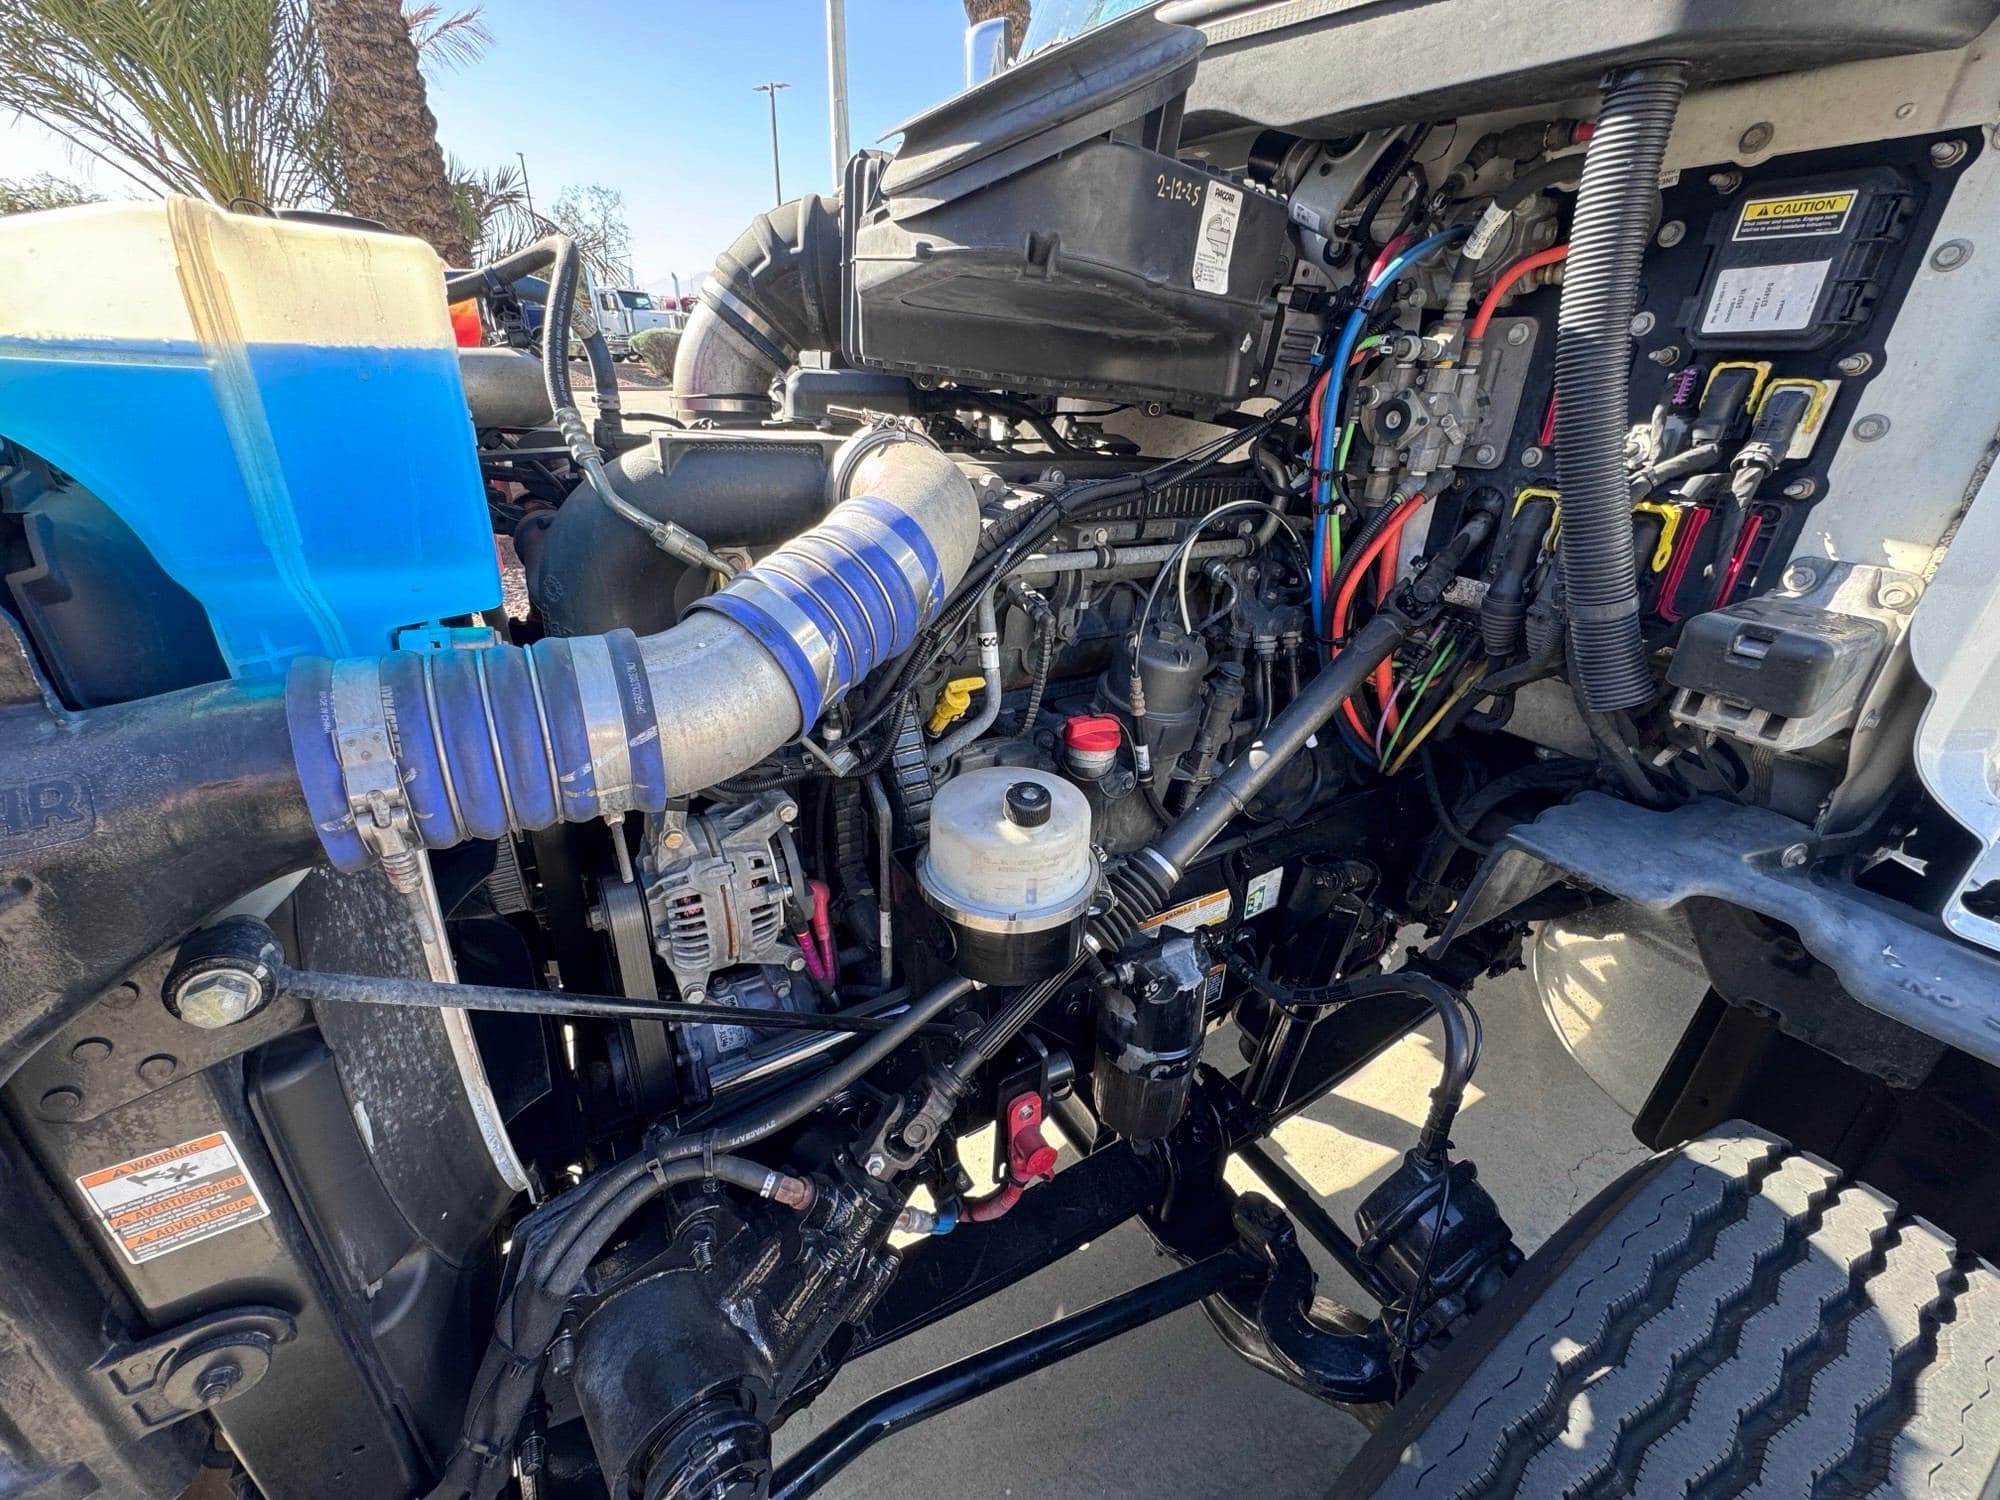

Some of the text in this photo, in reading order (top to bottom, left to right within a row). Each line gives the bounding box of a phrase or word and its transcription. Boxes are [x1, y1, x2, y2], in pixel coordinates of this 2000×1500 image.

[1214, 187, 1236, 204] PACCAR
[1771, 198, 1837, 215] CAUTION
[128, 1142, 200, 1173] WARNING
[133, 1174, 243, 1222] AVERTISSEMENT
[153, 1197, 249, 1240] ADVERTENCIA
